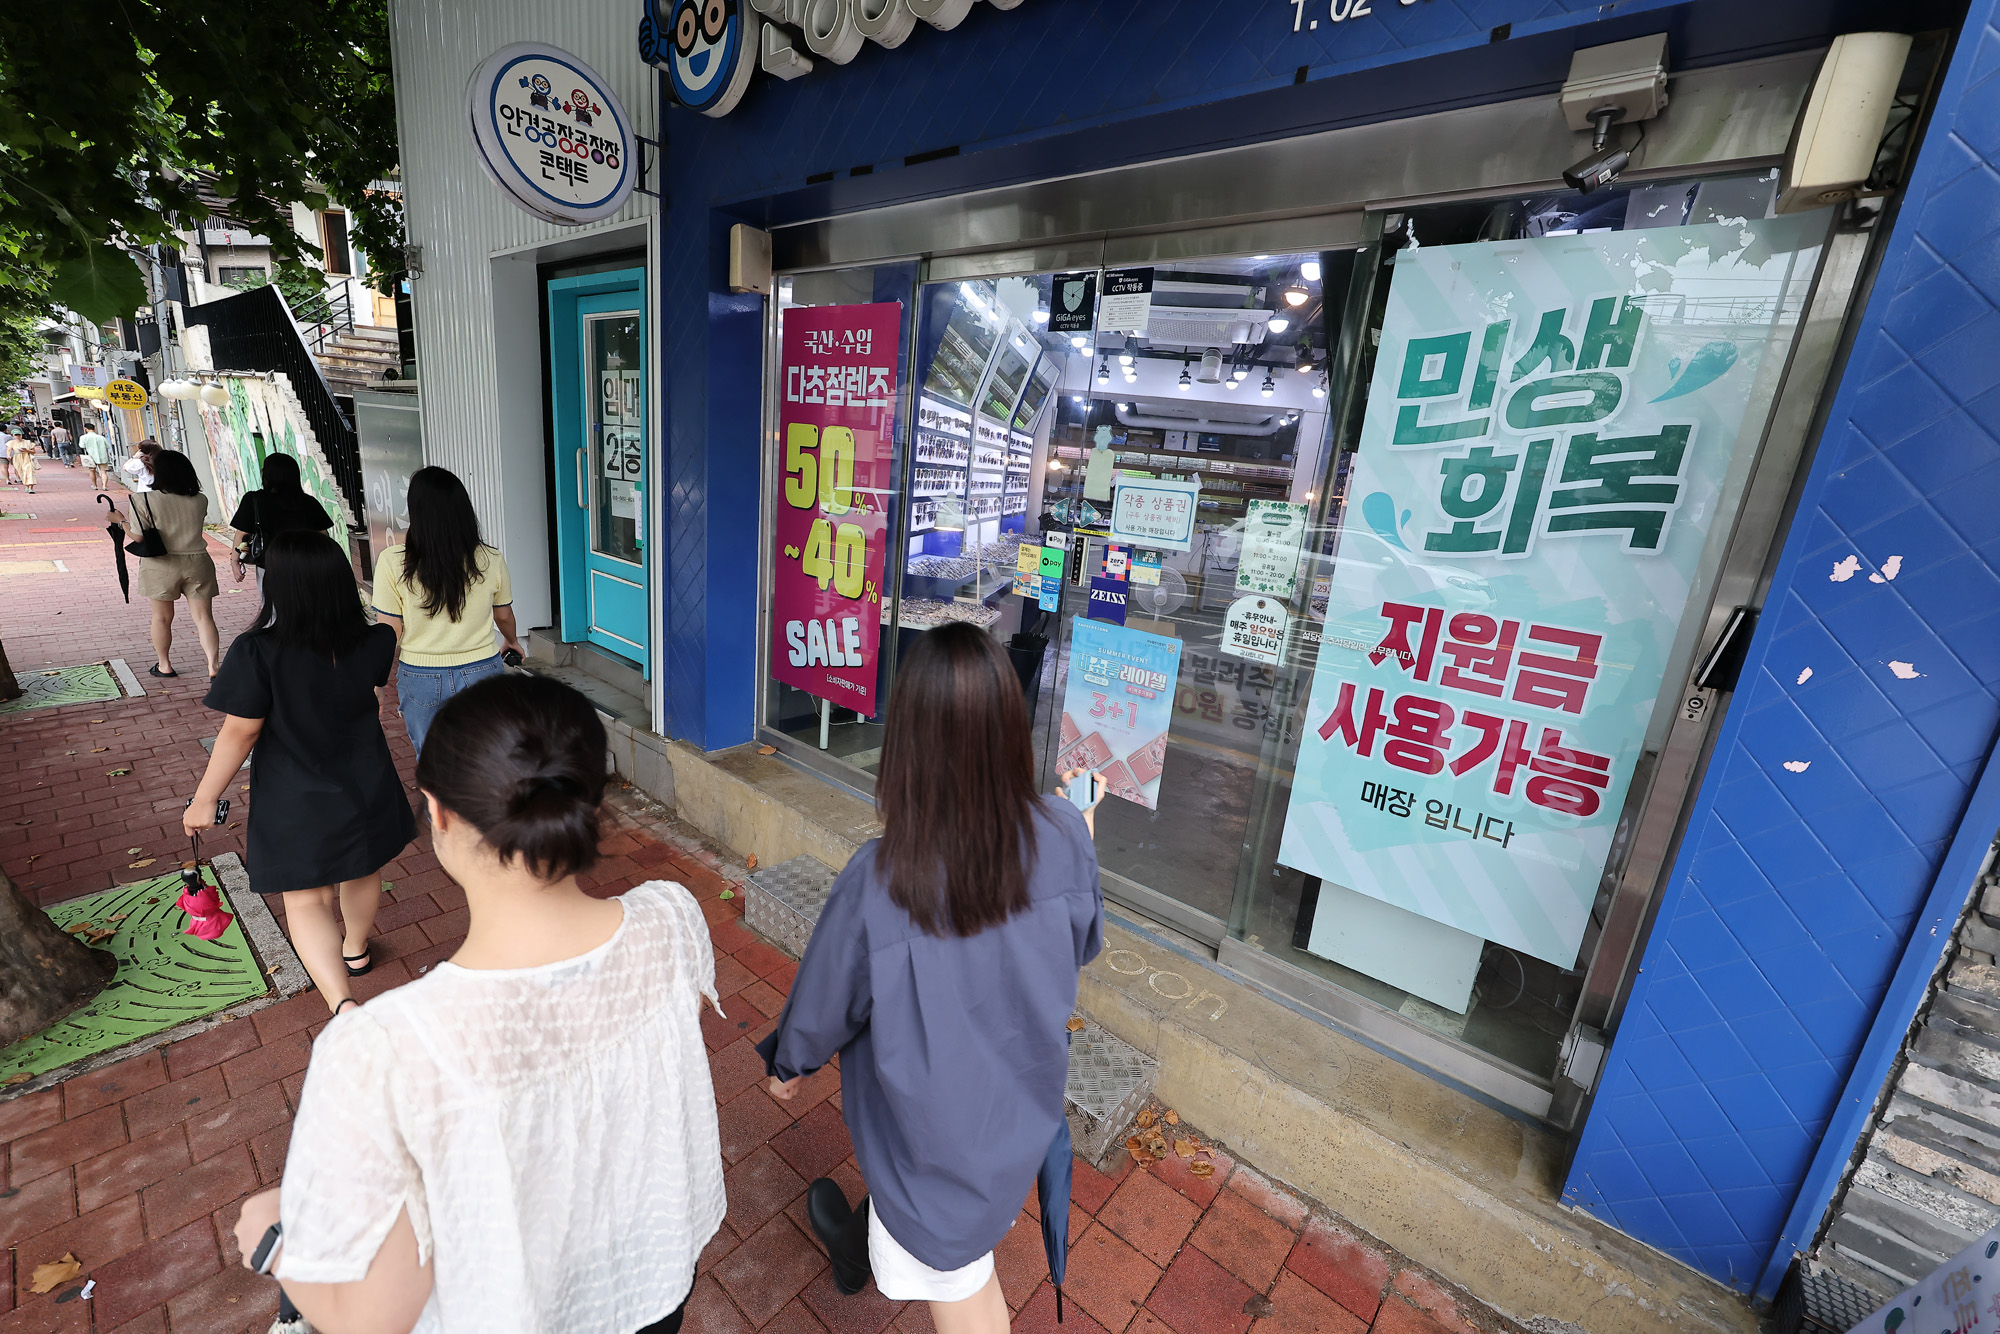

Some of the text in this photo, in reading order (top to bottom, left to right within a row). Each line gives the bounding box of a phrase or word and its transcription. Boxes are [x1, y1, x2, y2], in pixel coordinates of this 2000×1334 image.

[539, 150, 589, 186] 콘택트
[1112, 282, 1144, 292] CCTV 작동중
[1392, 295, 1644, 446] 민생
[113, 384, 135, 393] 대운
[787, 364, 890, 407] 다초점렌즈
[110, 392, 143, 402] 부동산
[603, 376, 640, 419] 임대
[606, 432, 641, 475] 2층
[1424, 424, 1693, 554] 회복
[1124, 493, 1187, 513] 각종 상품권
[1053, 536, 1064, 544] Pay
[1125, 524, 1176, 536] 사용 가능 매장입니다
[1272, 554, 1288, 562] 21:00
[1250, 568, 1264, 576] 11:00
[1090, 588, 1126, 605] ZEISS
[1230, 620, 1284, 640] 매주 일요일은
[786, 617, 863, 668] SALE
[1232, 632, 1278, 650] 휴일입니다
[1098, 647, 1149, 664] SUMMER EVENT
[1368, 601, 1603, 715] 지원금
[1089, 690, 1138, 729] 3+1
[1318, 682, 1611, 818] 사용가능
[1361, 781, 1515, 849] 매장 입니다
